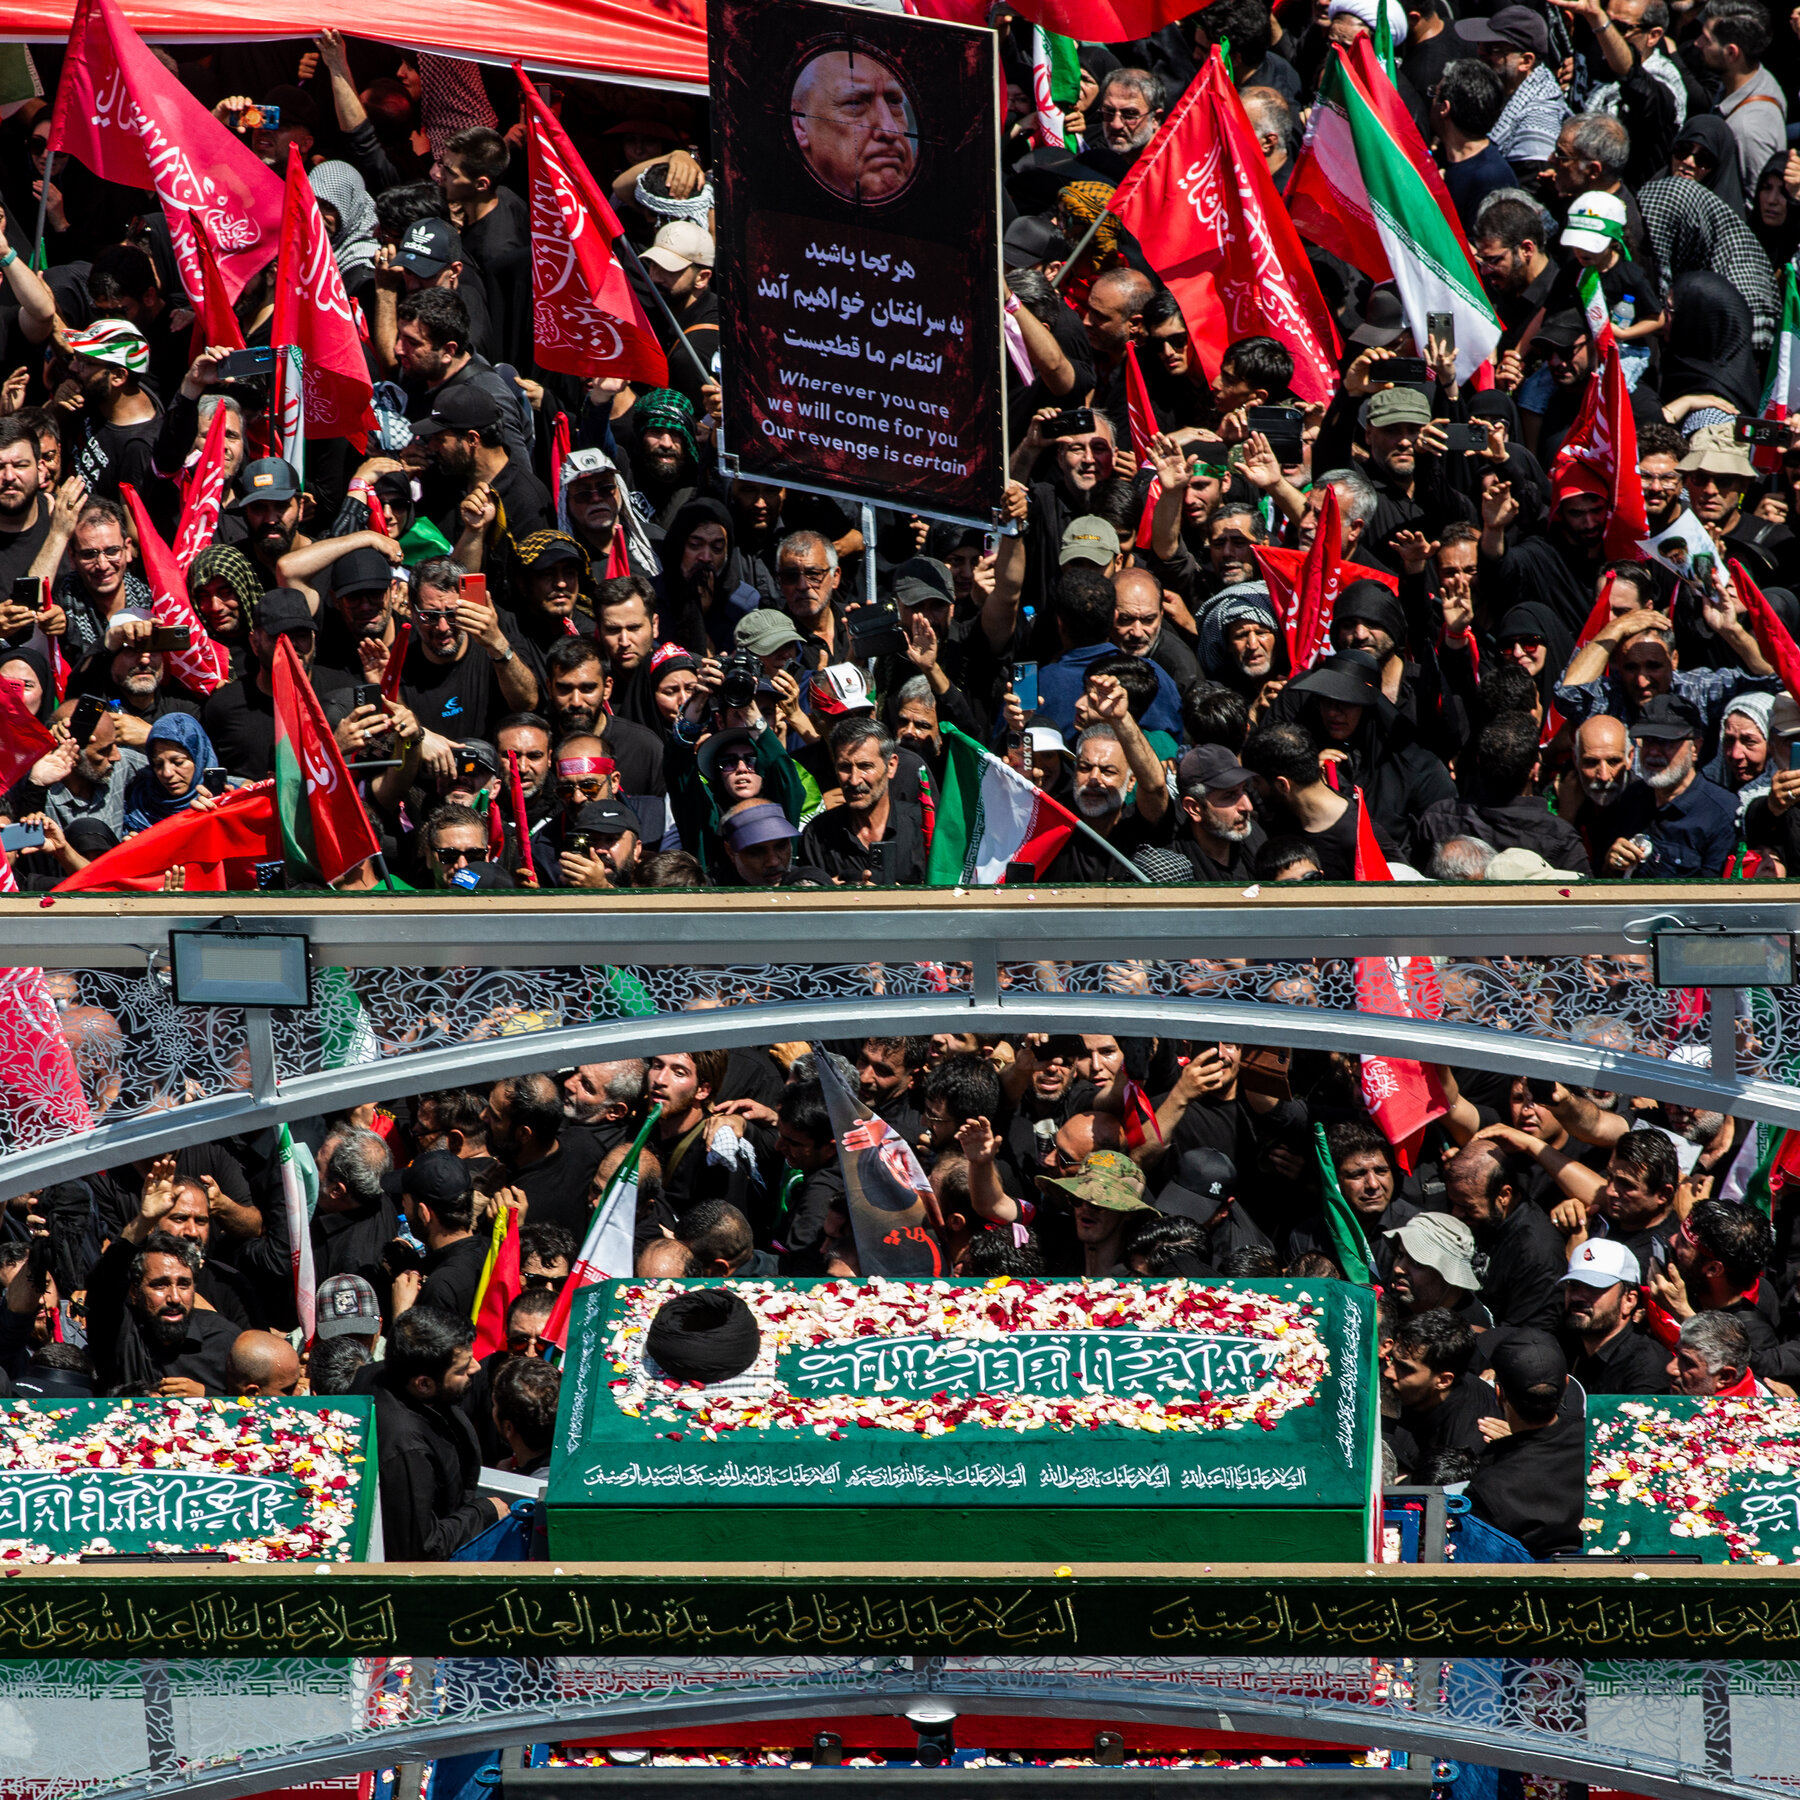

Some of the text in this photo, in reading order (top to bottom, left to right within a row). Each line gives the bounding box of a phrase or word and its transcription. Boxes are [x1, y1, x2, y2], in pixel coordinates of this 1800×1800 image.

[403, 240, 432, 256] adidas
[804, 242, 856, 272] باشید
[757, 273, 965, 342] به سراغتان خواهیم آمد
[783, 328, 943, 375] انتقام ما قطعیست
[779, 368, 950, 419] Wherever you are
[767, 397, 958, 448] we will come for you
[761, 419, 968, 476] Our revenge is certain
[1023, 736, 1033, 771] TOKYO
